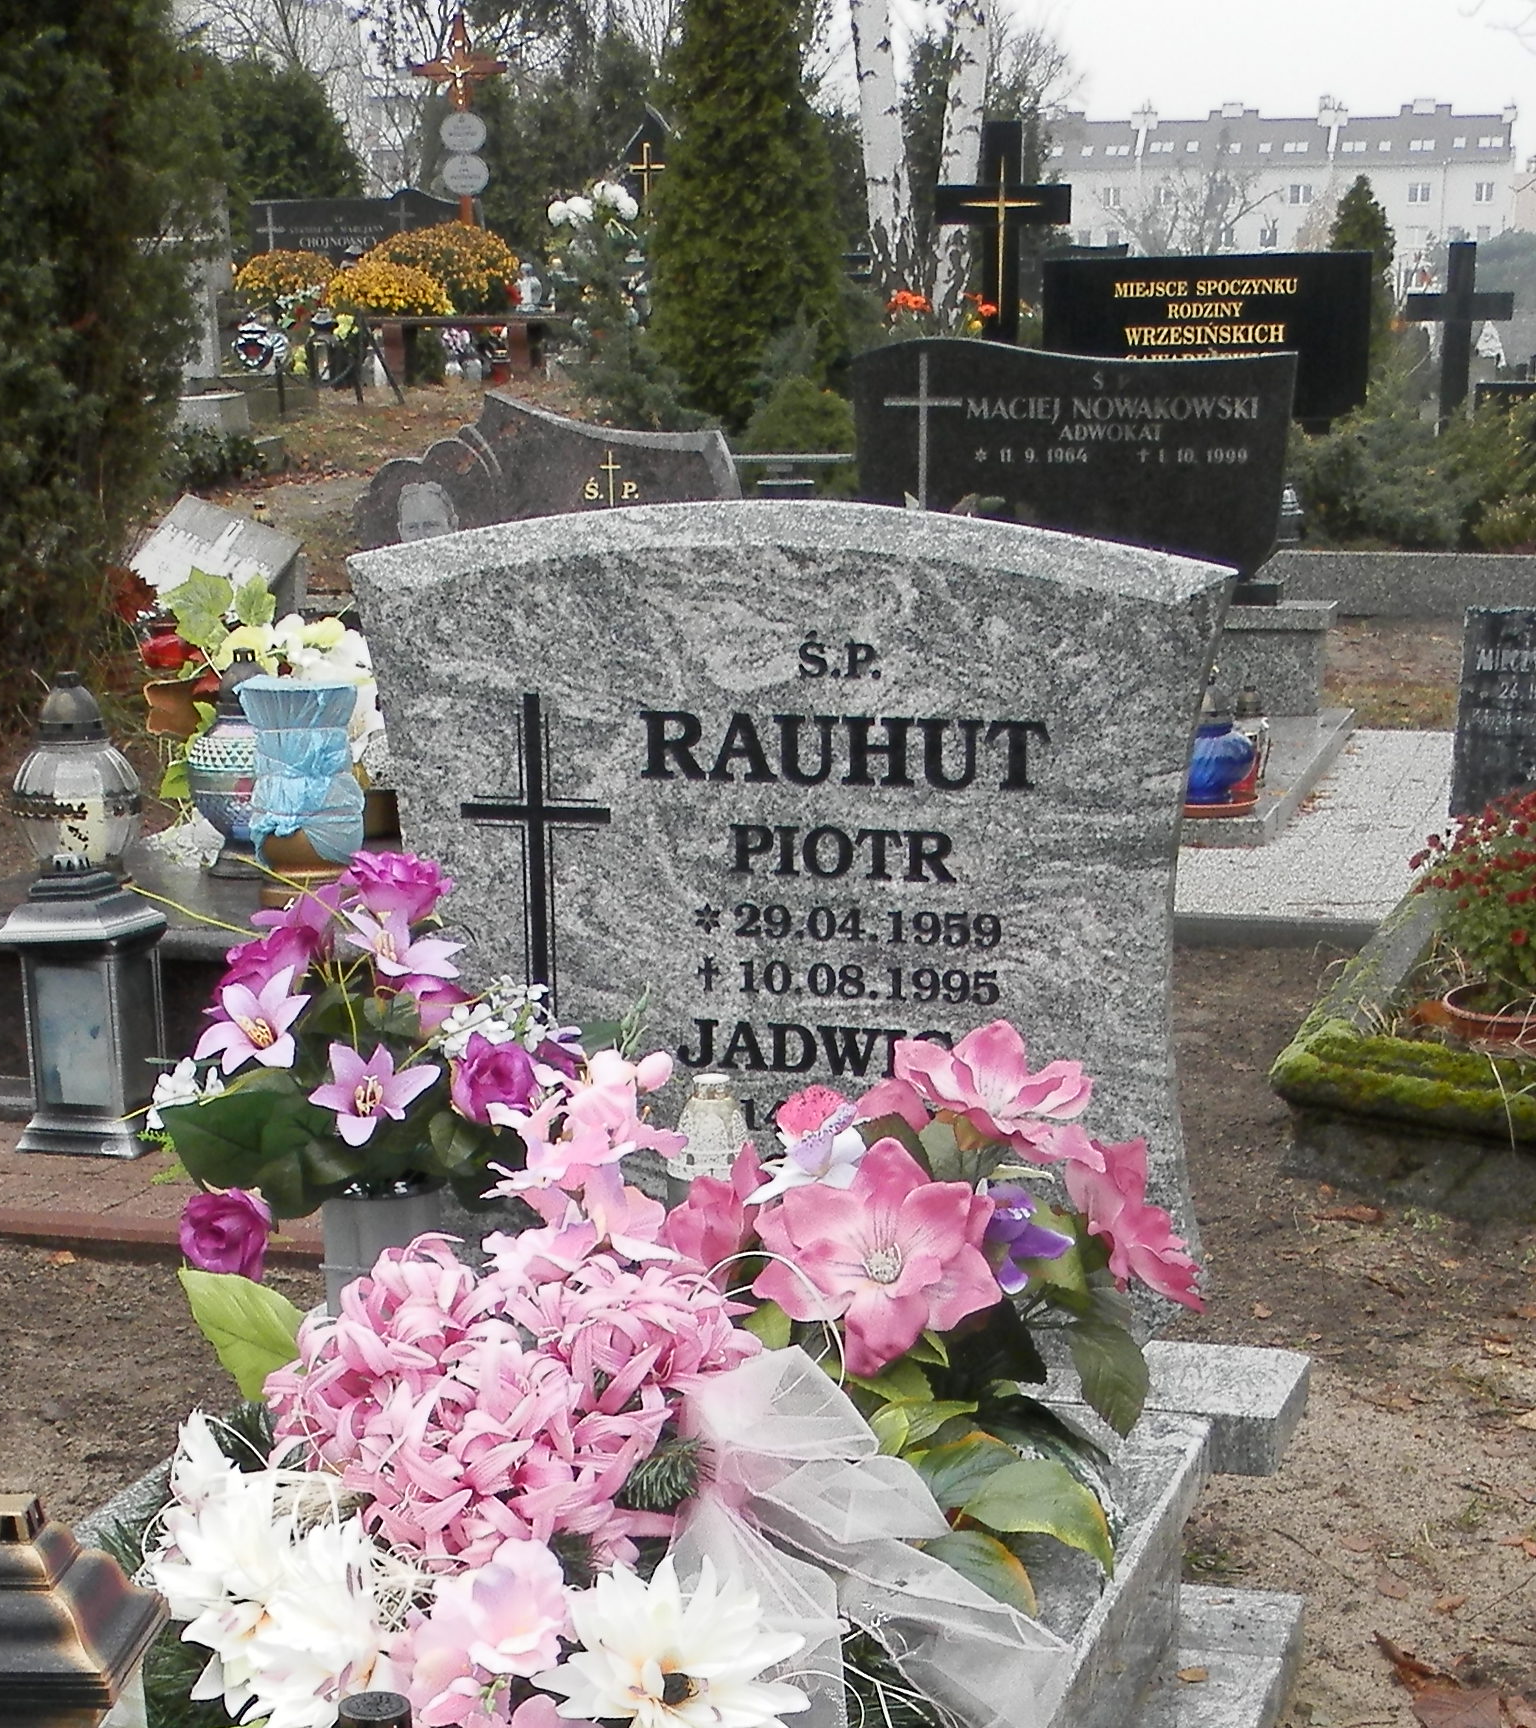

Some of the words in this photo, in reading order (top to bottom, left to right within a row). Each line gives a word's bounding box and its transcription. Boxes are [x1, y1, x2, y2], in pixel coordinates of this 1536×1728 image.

[1114, 280, 1188, 298] MIEJSCE
[1196, 277, 1298, 296] SPOCZYNKU
[1167, 301, 1244, 319] RODZINY
[1124, 322, 1285, 347] WRZESIŃSKICH
[966, 396, 1061, 425] MACIEJ
[1072, 396, 1261, 421] NOWAKOWSKI
[1058, 423, 1164, 442] ADWOKAT
[797, 630, 882, 681] Ś.P.
[638, 709, 1052, 792] RAUHUT
[729, 823, 958, 884] PIOTR
[732, 902, 1004, 950] 29.04.1959
[738, 958, 1003, 1007] 10.08.1995
